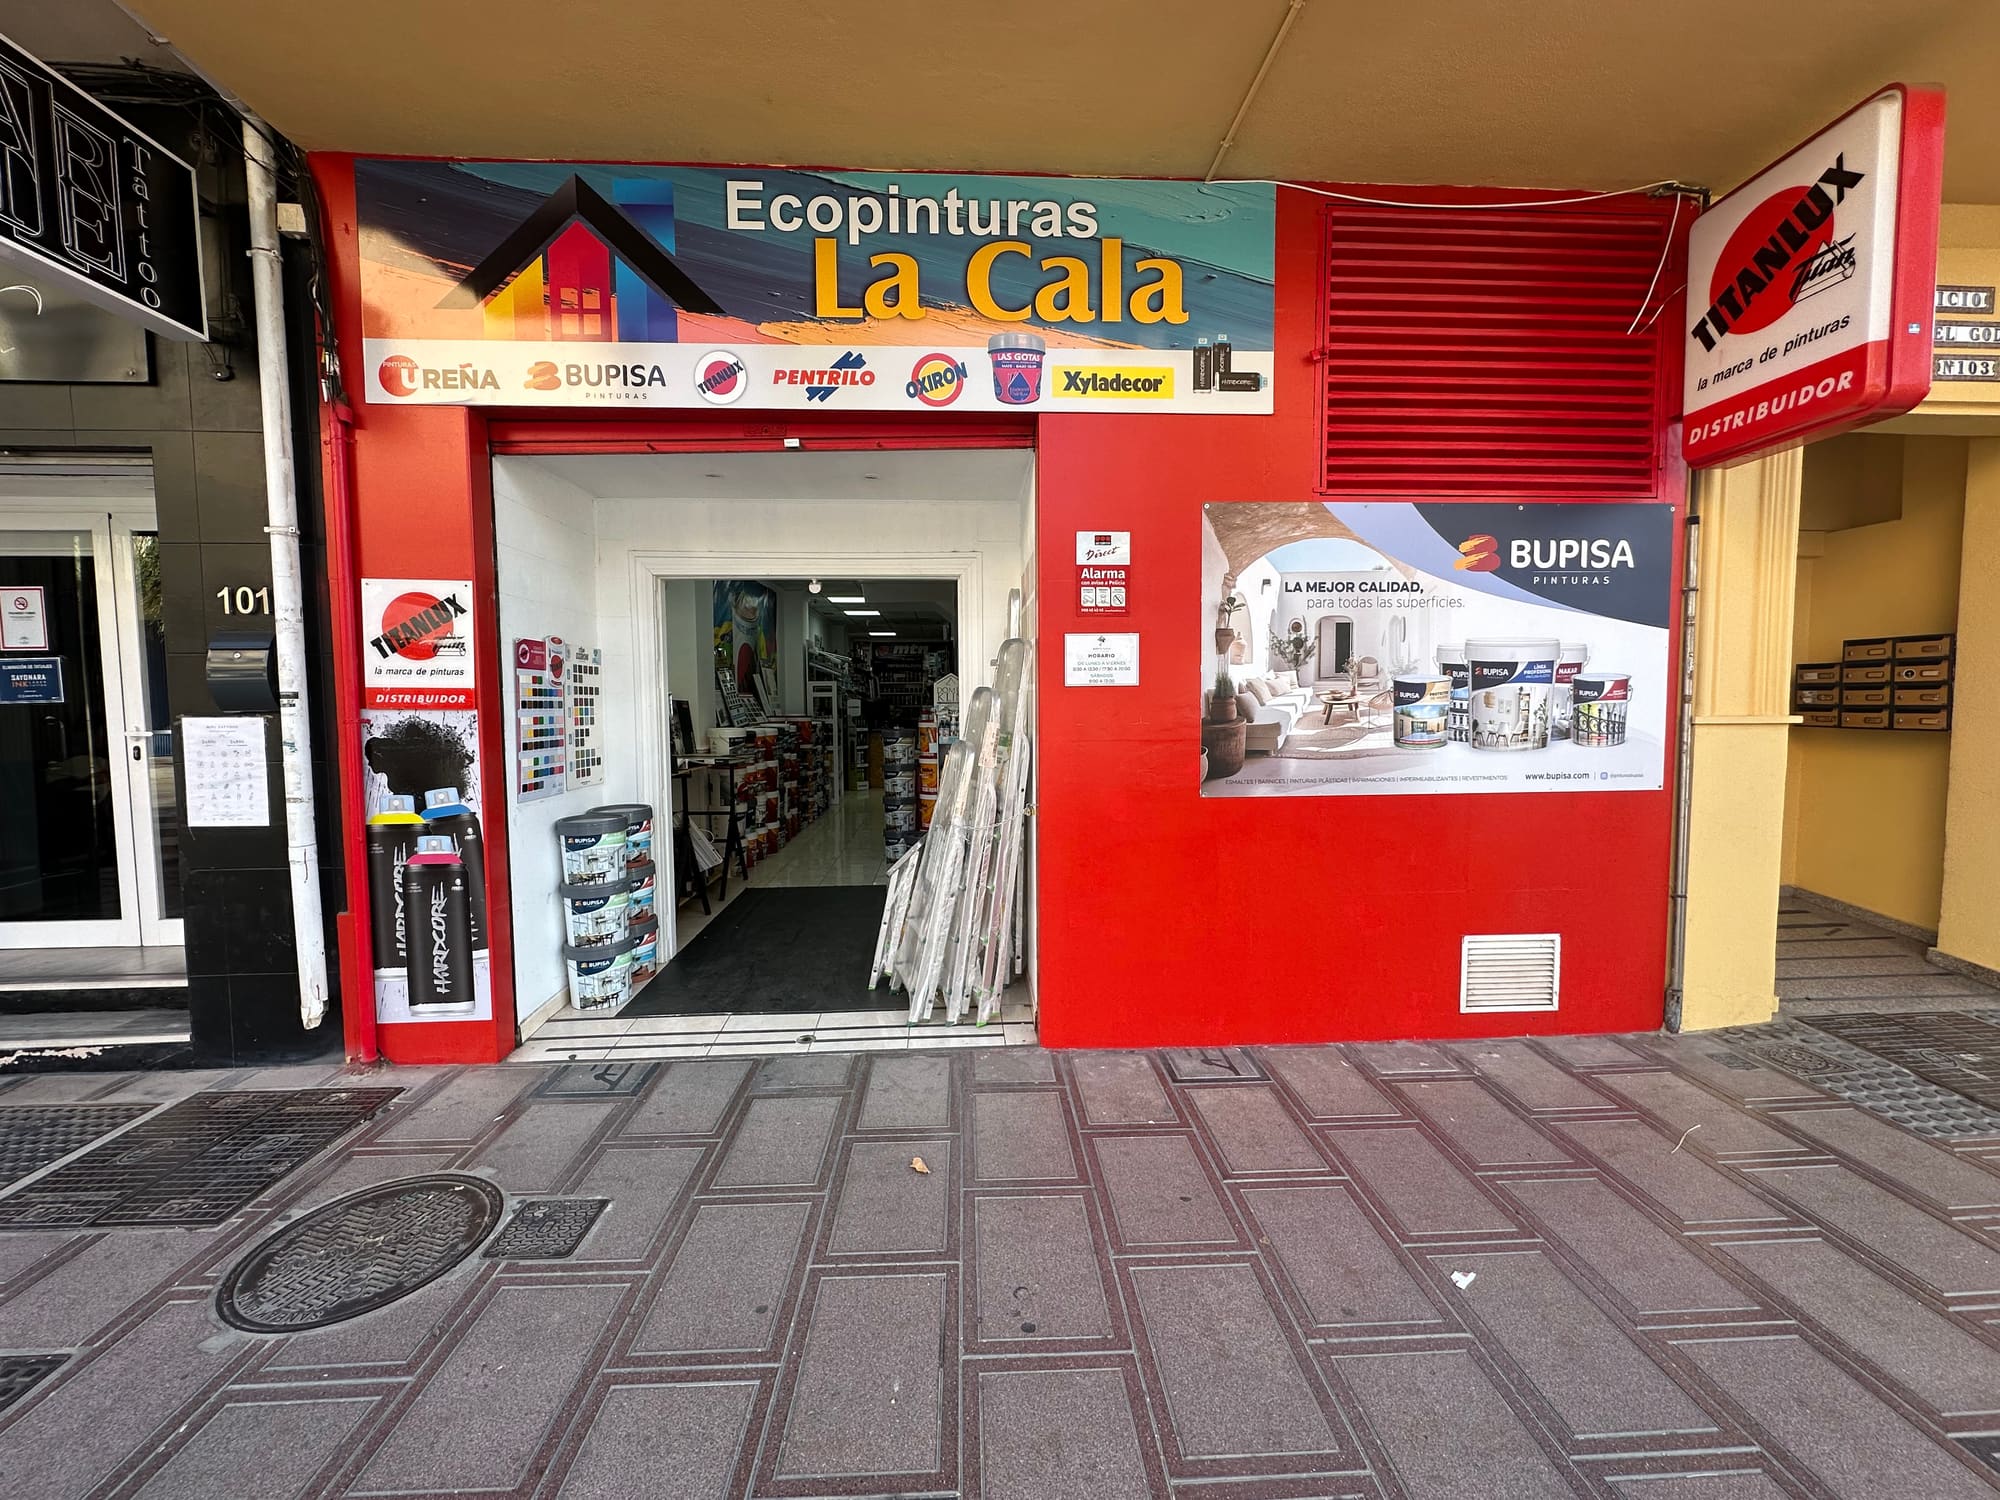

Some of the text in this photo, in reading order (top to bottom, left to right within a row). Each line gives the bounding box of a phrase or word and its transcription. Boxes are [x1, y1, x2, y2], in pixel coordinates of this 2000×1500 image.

[726, 179, 1099, 245] Ecopinturas
[1691, 152, 1866, 352] TITANLUX
[815, 237, 1190, 324] La Cala
[997, 352, 1040, 362] LAS GOTAS
[1696, 314, 1851, 391] la marca de pinturas
[566, 363, 666, 388] BUPISA
[697, 359, 745, 395] TITANLUX
[773, 369, 876, 386] PENTRILO
[905, 361, 969, 399] OXIRON
[1062, 370, 1165, 397] Xyladecor
[585, 392, 648, 400] PINTURAS
[1688, 370, 1854, 446] DISTRIBUIDOR
[1510, 538, 1635, 569] BUPISA
[1080, 568, 1126, 579] Alarma
[1533, 576, 1611, 585] PINTURAS
[216, 586, 271, 615] 101
[1284, 581, 1424, 594] LA MEJOR CALIDAD,
[1306, 595, 1466, 610] para todas las superficies.
[370, 593, 468, 660] TITANLUX
[374, 667, 465, 677] la marca de pinturas
[1482, 668, 1509, 677] BUPISA
[375, 694, 467, 704] DISTRIBUIDOR
[1525, 772, 1590, 781] www.bupisa.com
[430, 880, 449, 994] HARDCORE
